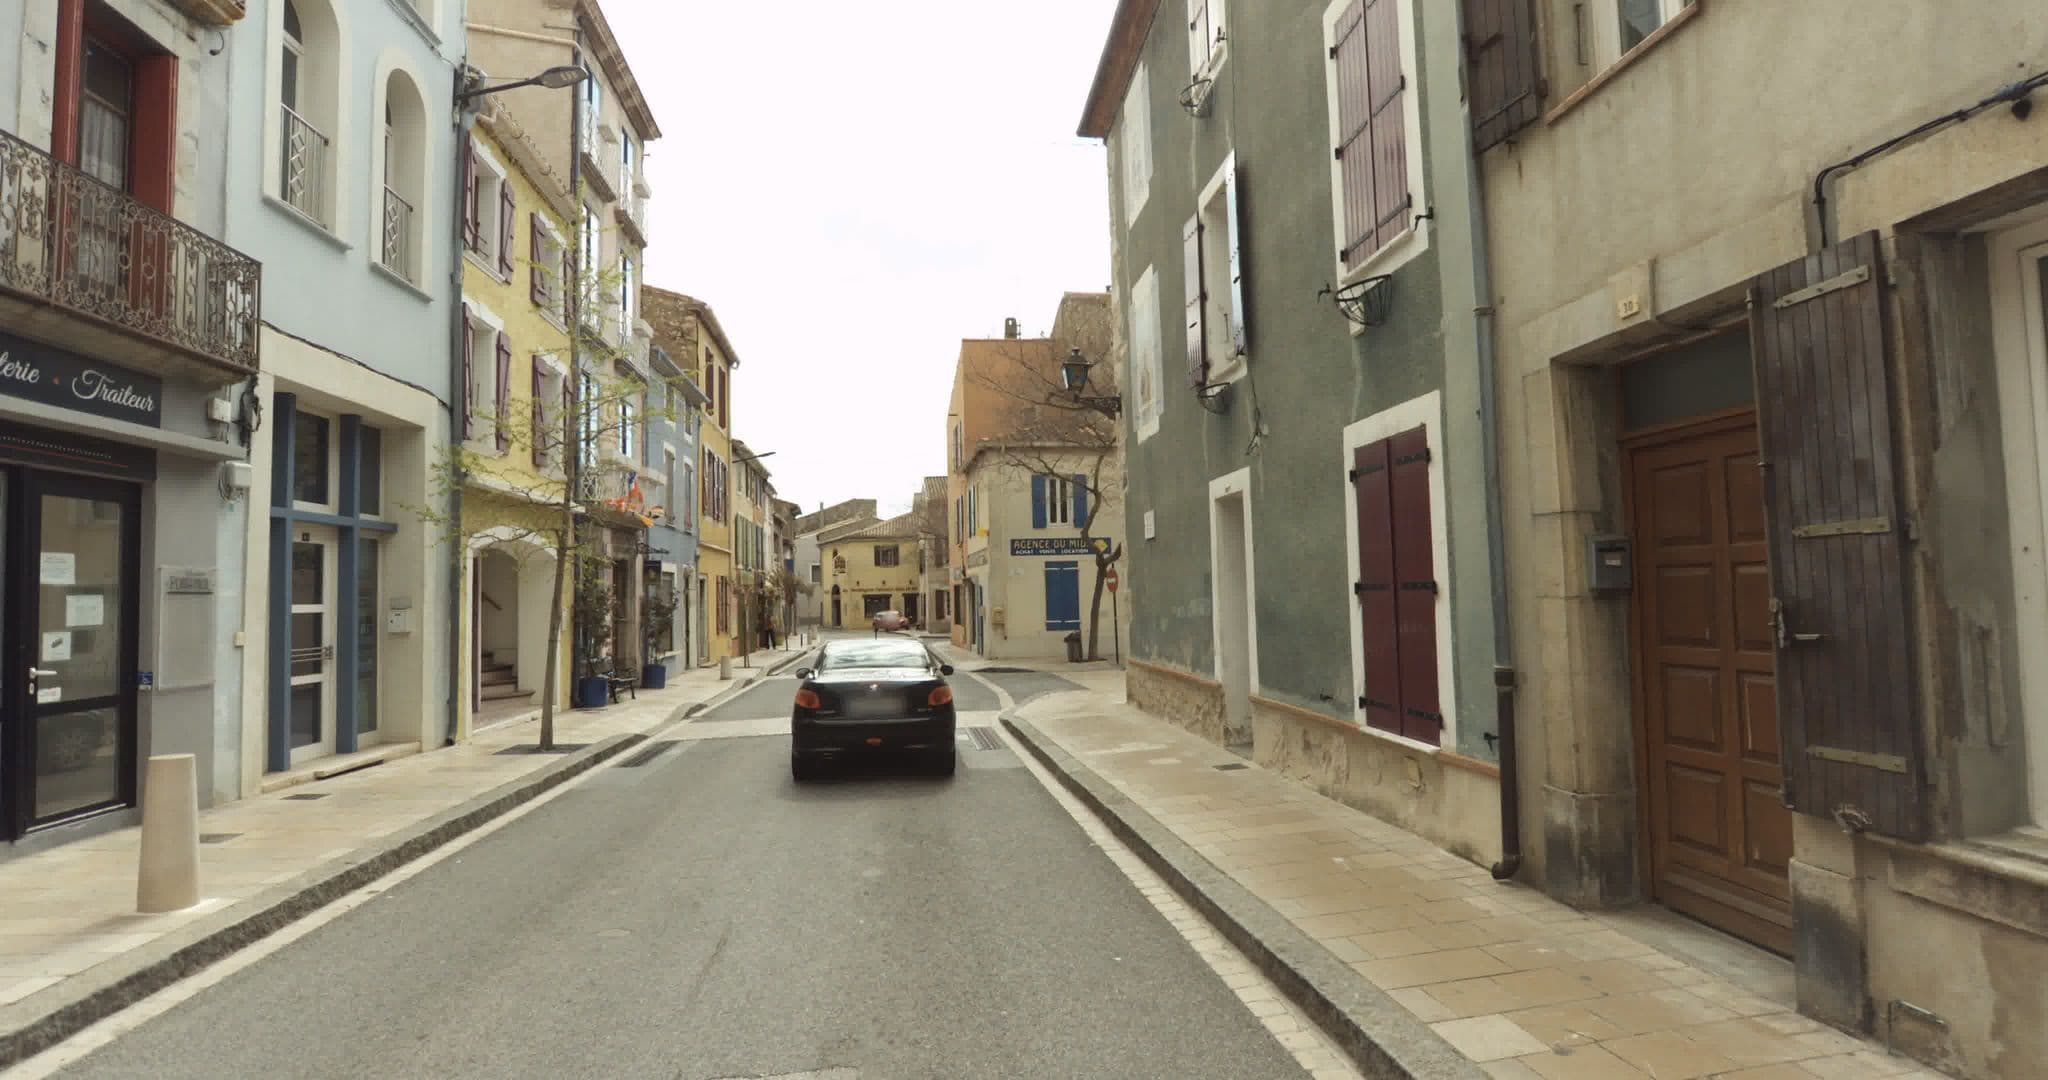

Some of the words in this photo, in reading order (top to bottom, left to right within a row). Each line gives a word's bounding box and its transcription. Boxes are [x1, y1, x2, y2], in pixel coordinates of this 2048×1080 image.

[72, 369, 155, 412] Traiteur
[1014, 539, 1049, 549] AGENCE
[1053, 539, 1066, 549] DU
[1069, 539, 1088, 548] MID
